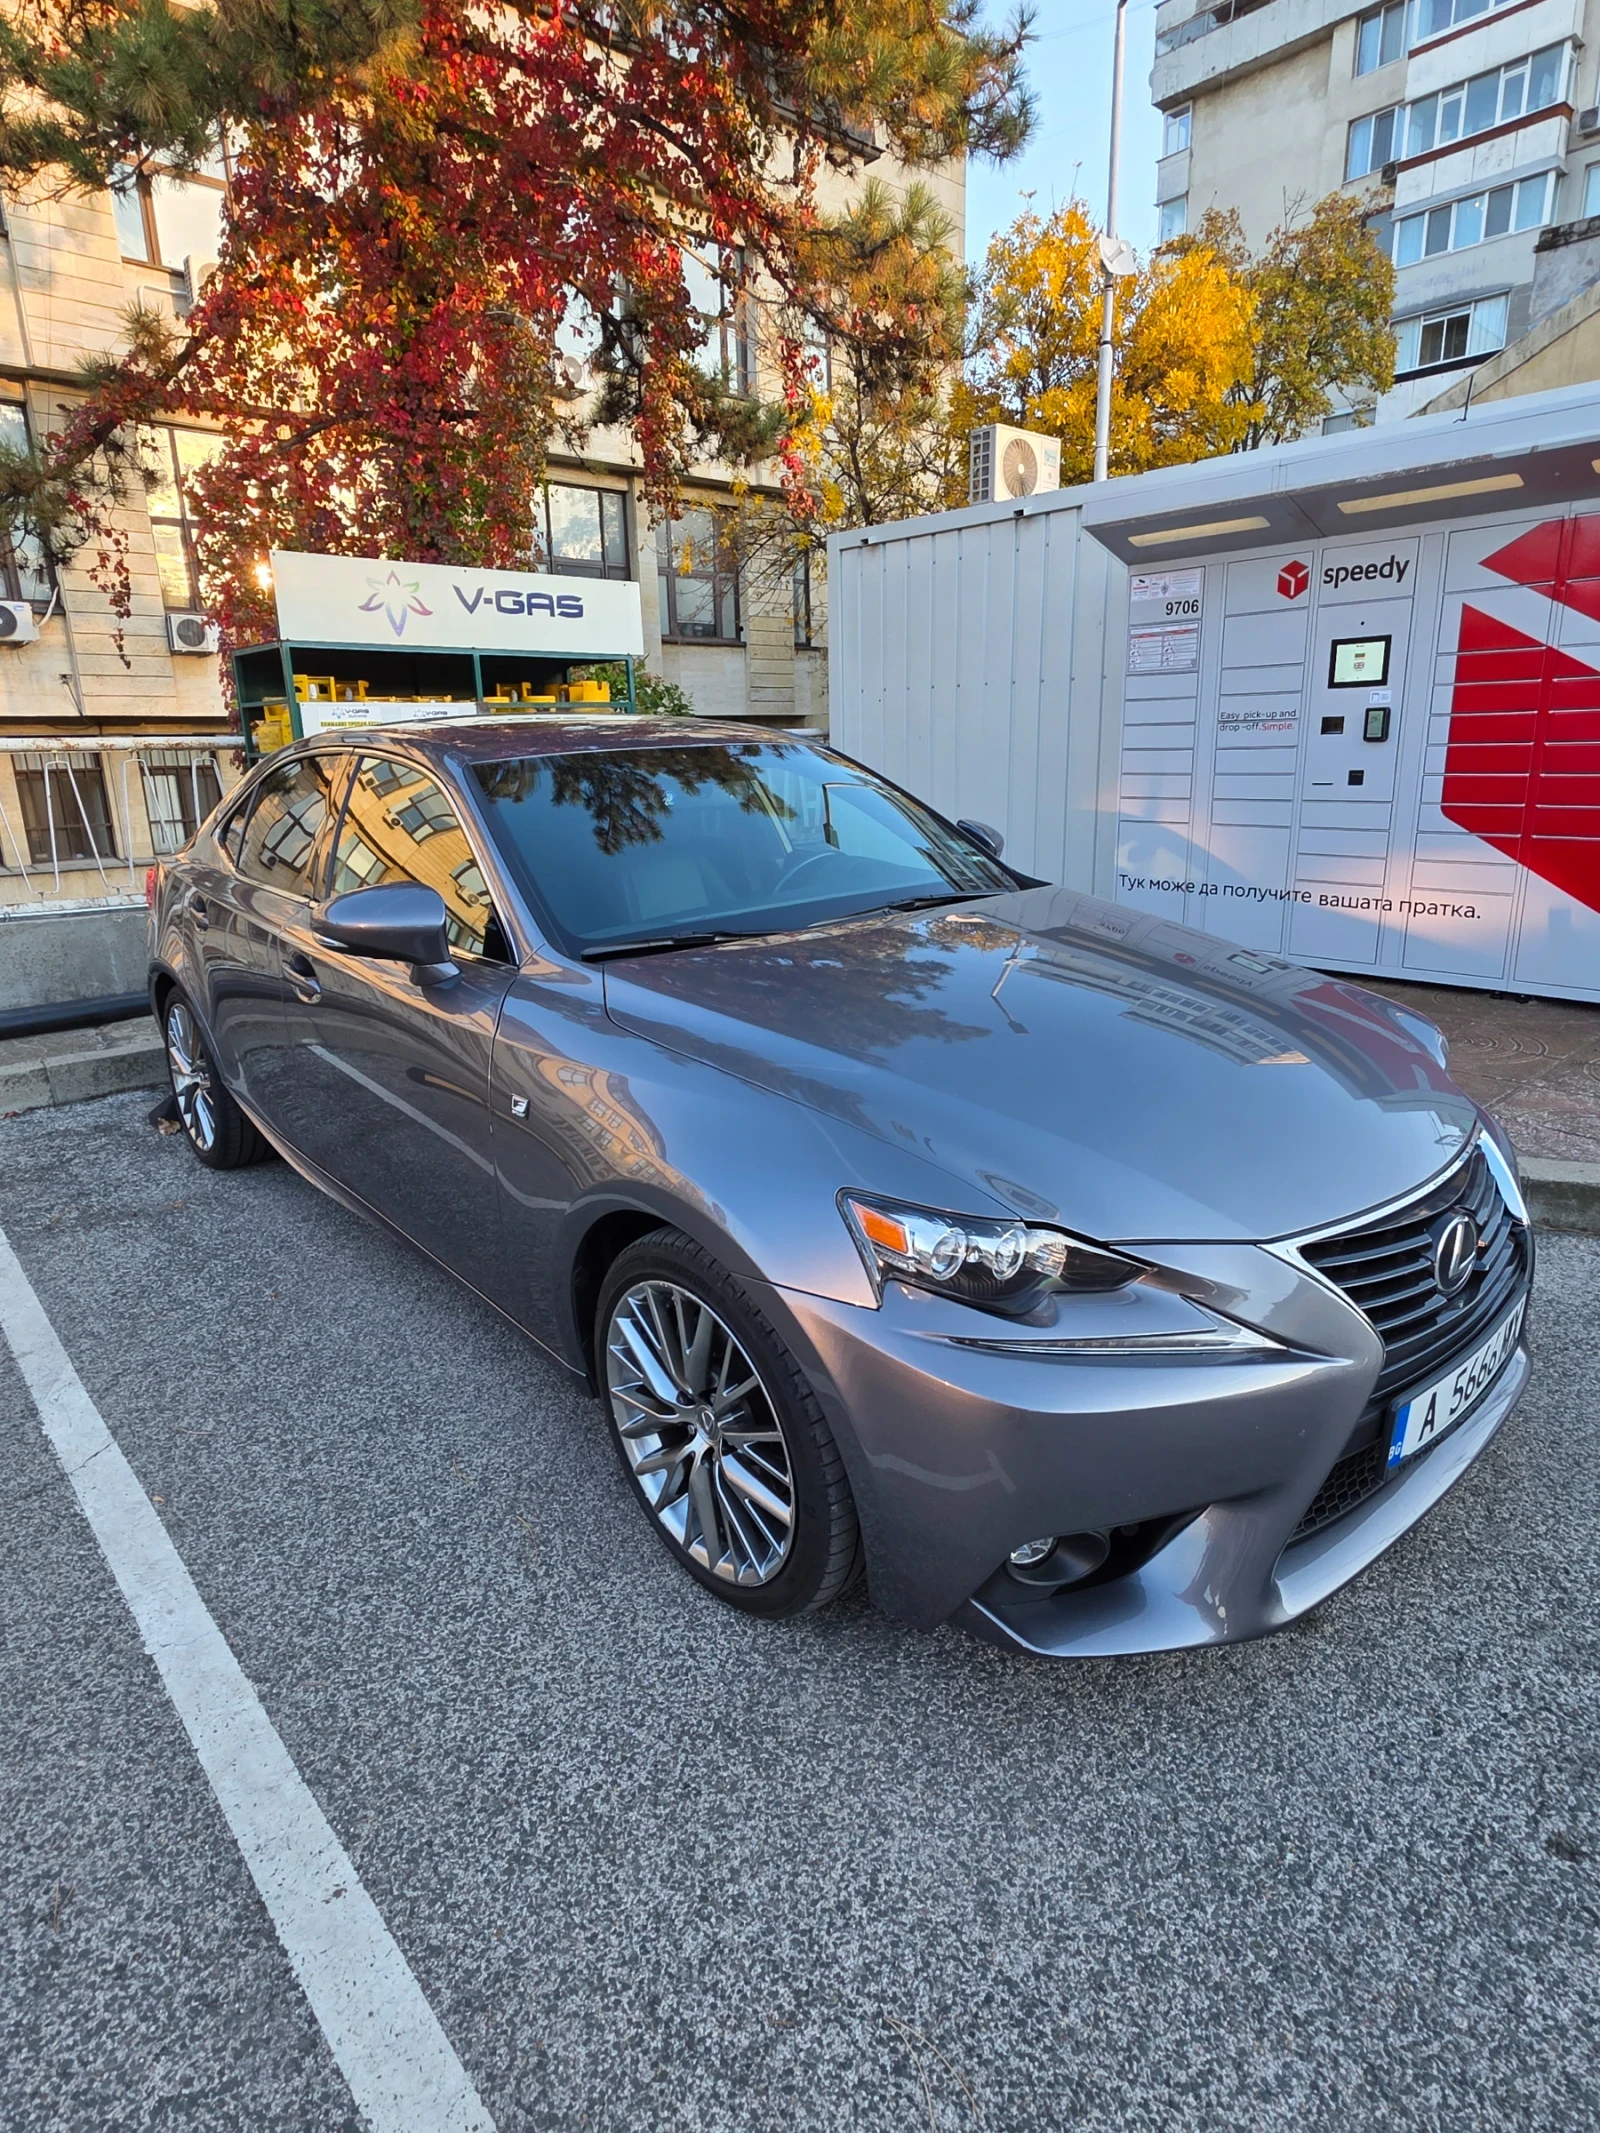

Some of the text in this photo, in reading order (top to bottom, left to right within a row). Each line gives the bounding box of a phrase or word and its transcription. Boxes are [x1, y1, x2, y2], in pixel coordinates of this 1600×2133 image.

[1323, 555, 1410, 589] speedy
[452, 584, 584, 618] V-GAS
[1165, 599, 1199, 616] 9706
[1220, 708, 1297, 721] Easy pick-up and
[1119, 874, 1482, 920] Тук може да получите вашата пратка.
[1418, 1391, 1438, 1443] A
[1388, 1441, 1403, 1462] BG
